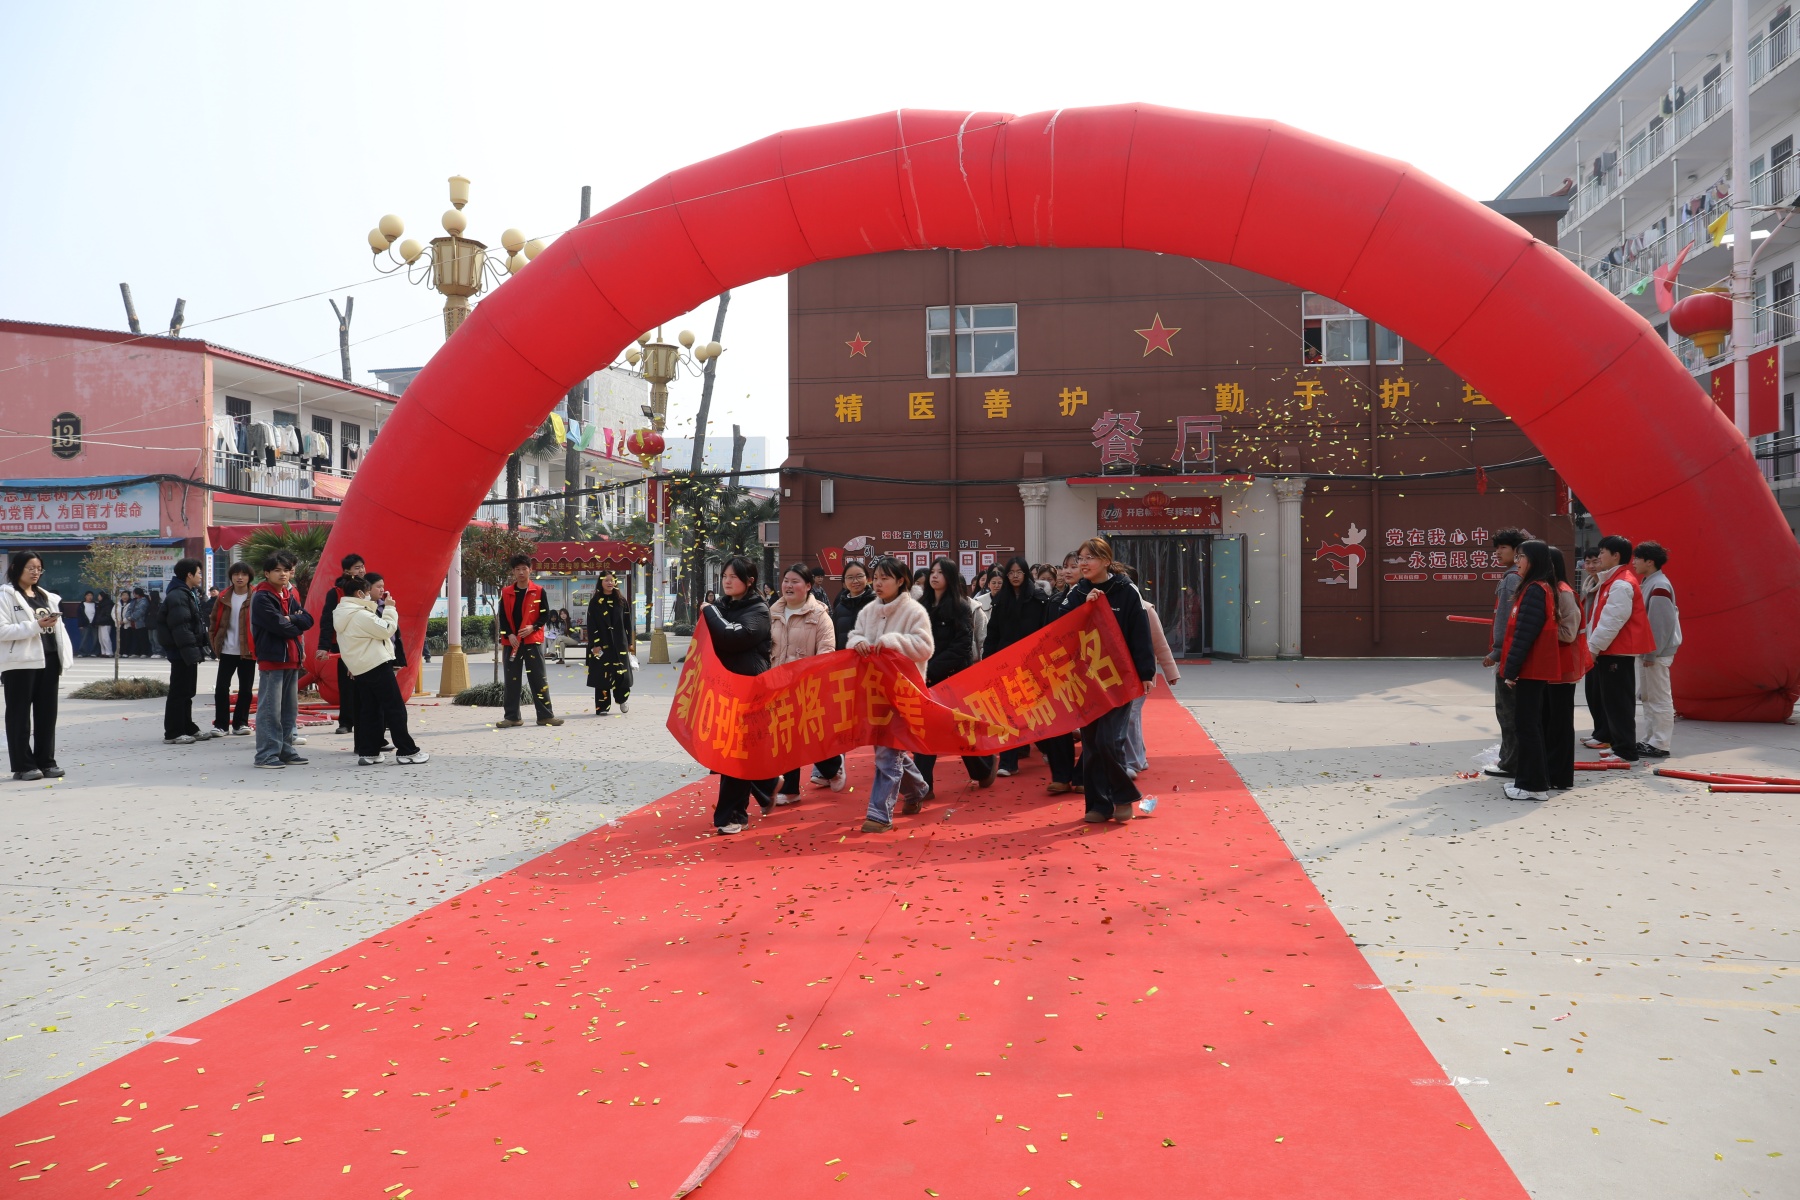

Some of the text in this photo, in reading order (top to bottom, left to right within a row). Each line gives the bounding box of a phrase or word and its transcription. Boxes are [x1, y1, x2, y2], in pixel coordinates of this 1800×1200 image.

[834, 387, 1089, 423] 精医善护
[1092, 411, 1223, 465] 餐厅
[0, 488, 120, 502] 忘立德树人初心
[57, 501, 143, 519] 为国育才使命
[1386, 527, 1489, 546] 党在我心中
[1408, 550, 1508, 569] 永远跟党走
